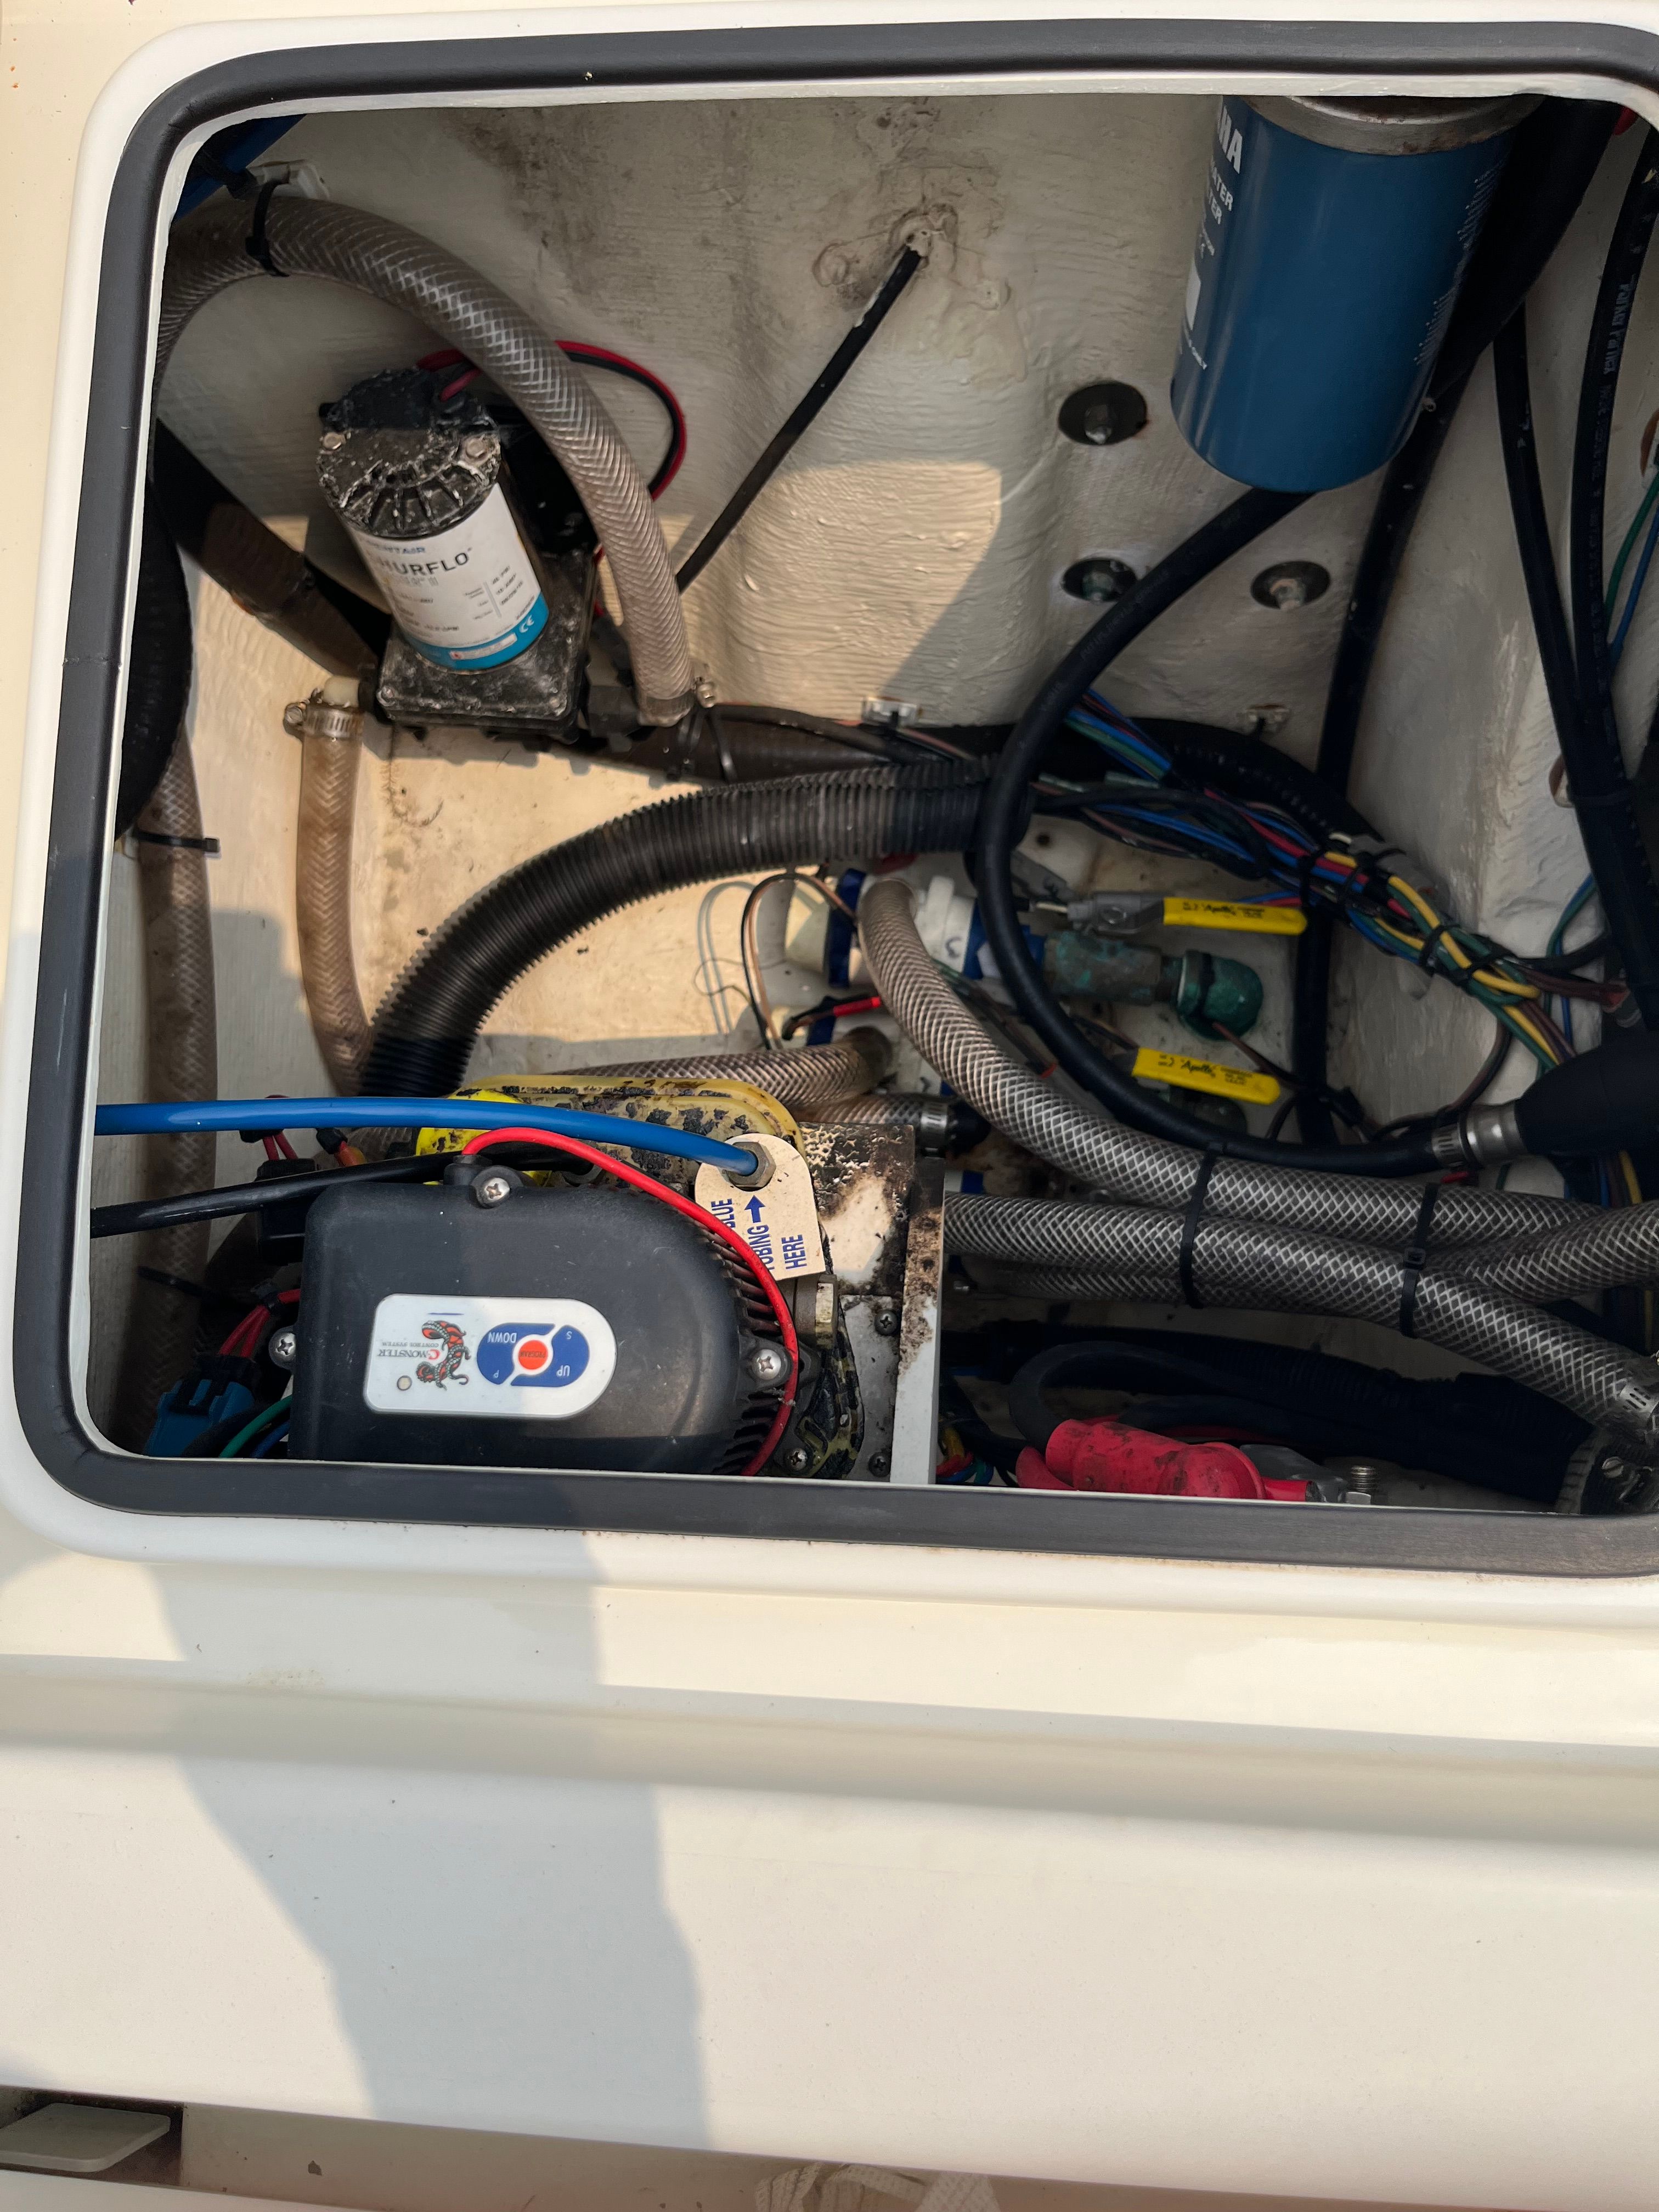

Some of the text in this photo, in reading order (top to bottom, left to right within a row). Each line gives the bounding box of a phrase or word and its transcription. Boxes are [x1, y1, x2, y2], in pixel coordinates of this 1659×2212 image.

[1207, 189, 1222, 225] TER
[369, 542, 426, 554] NTAIR
[747, 1224, 775, 1271] UBING
[781, 1234, 808, 1269] HERE
[487, 1331, 517, 1344] DOWN
[566, 1330, 573, 1340] S
[377, 1348, 441, 1360] C-MONSTER
[493, 1369, 500, 1379] P
[556, 1364, 571, 1378] UP
